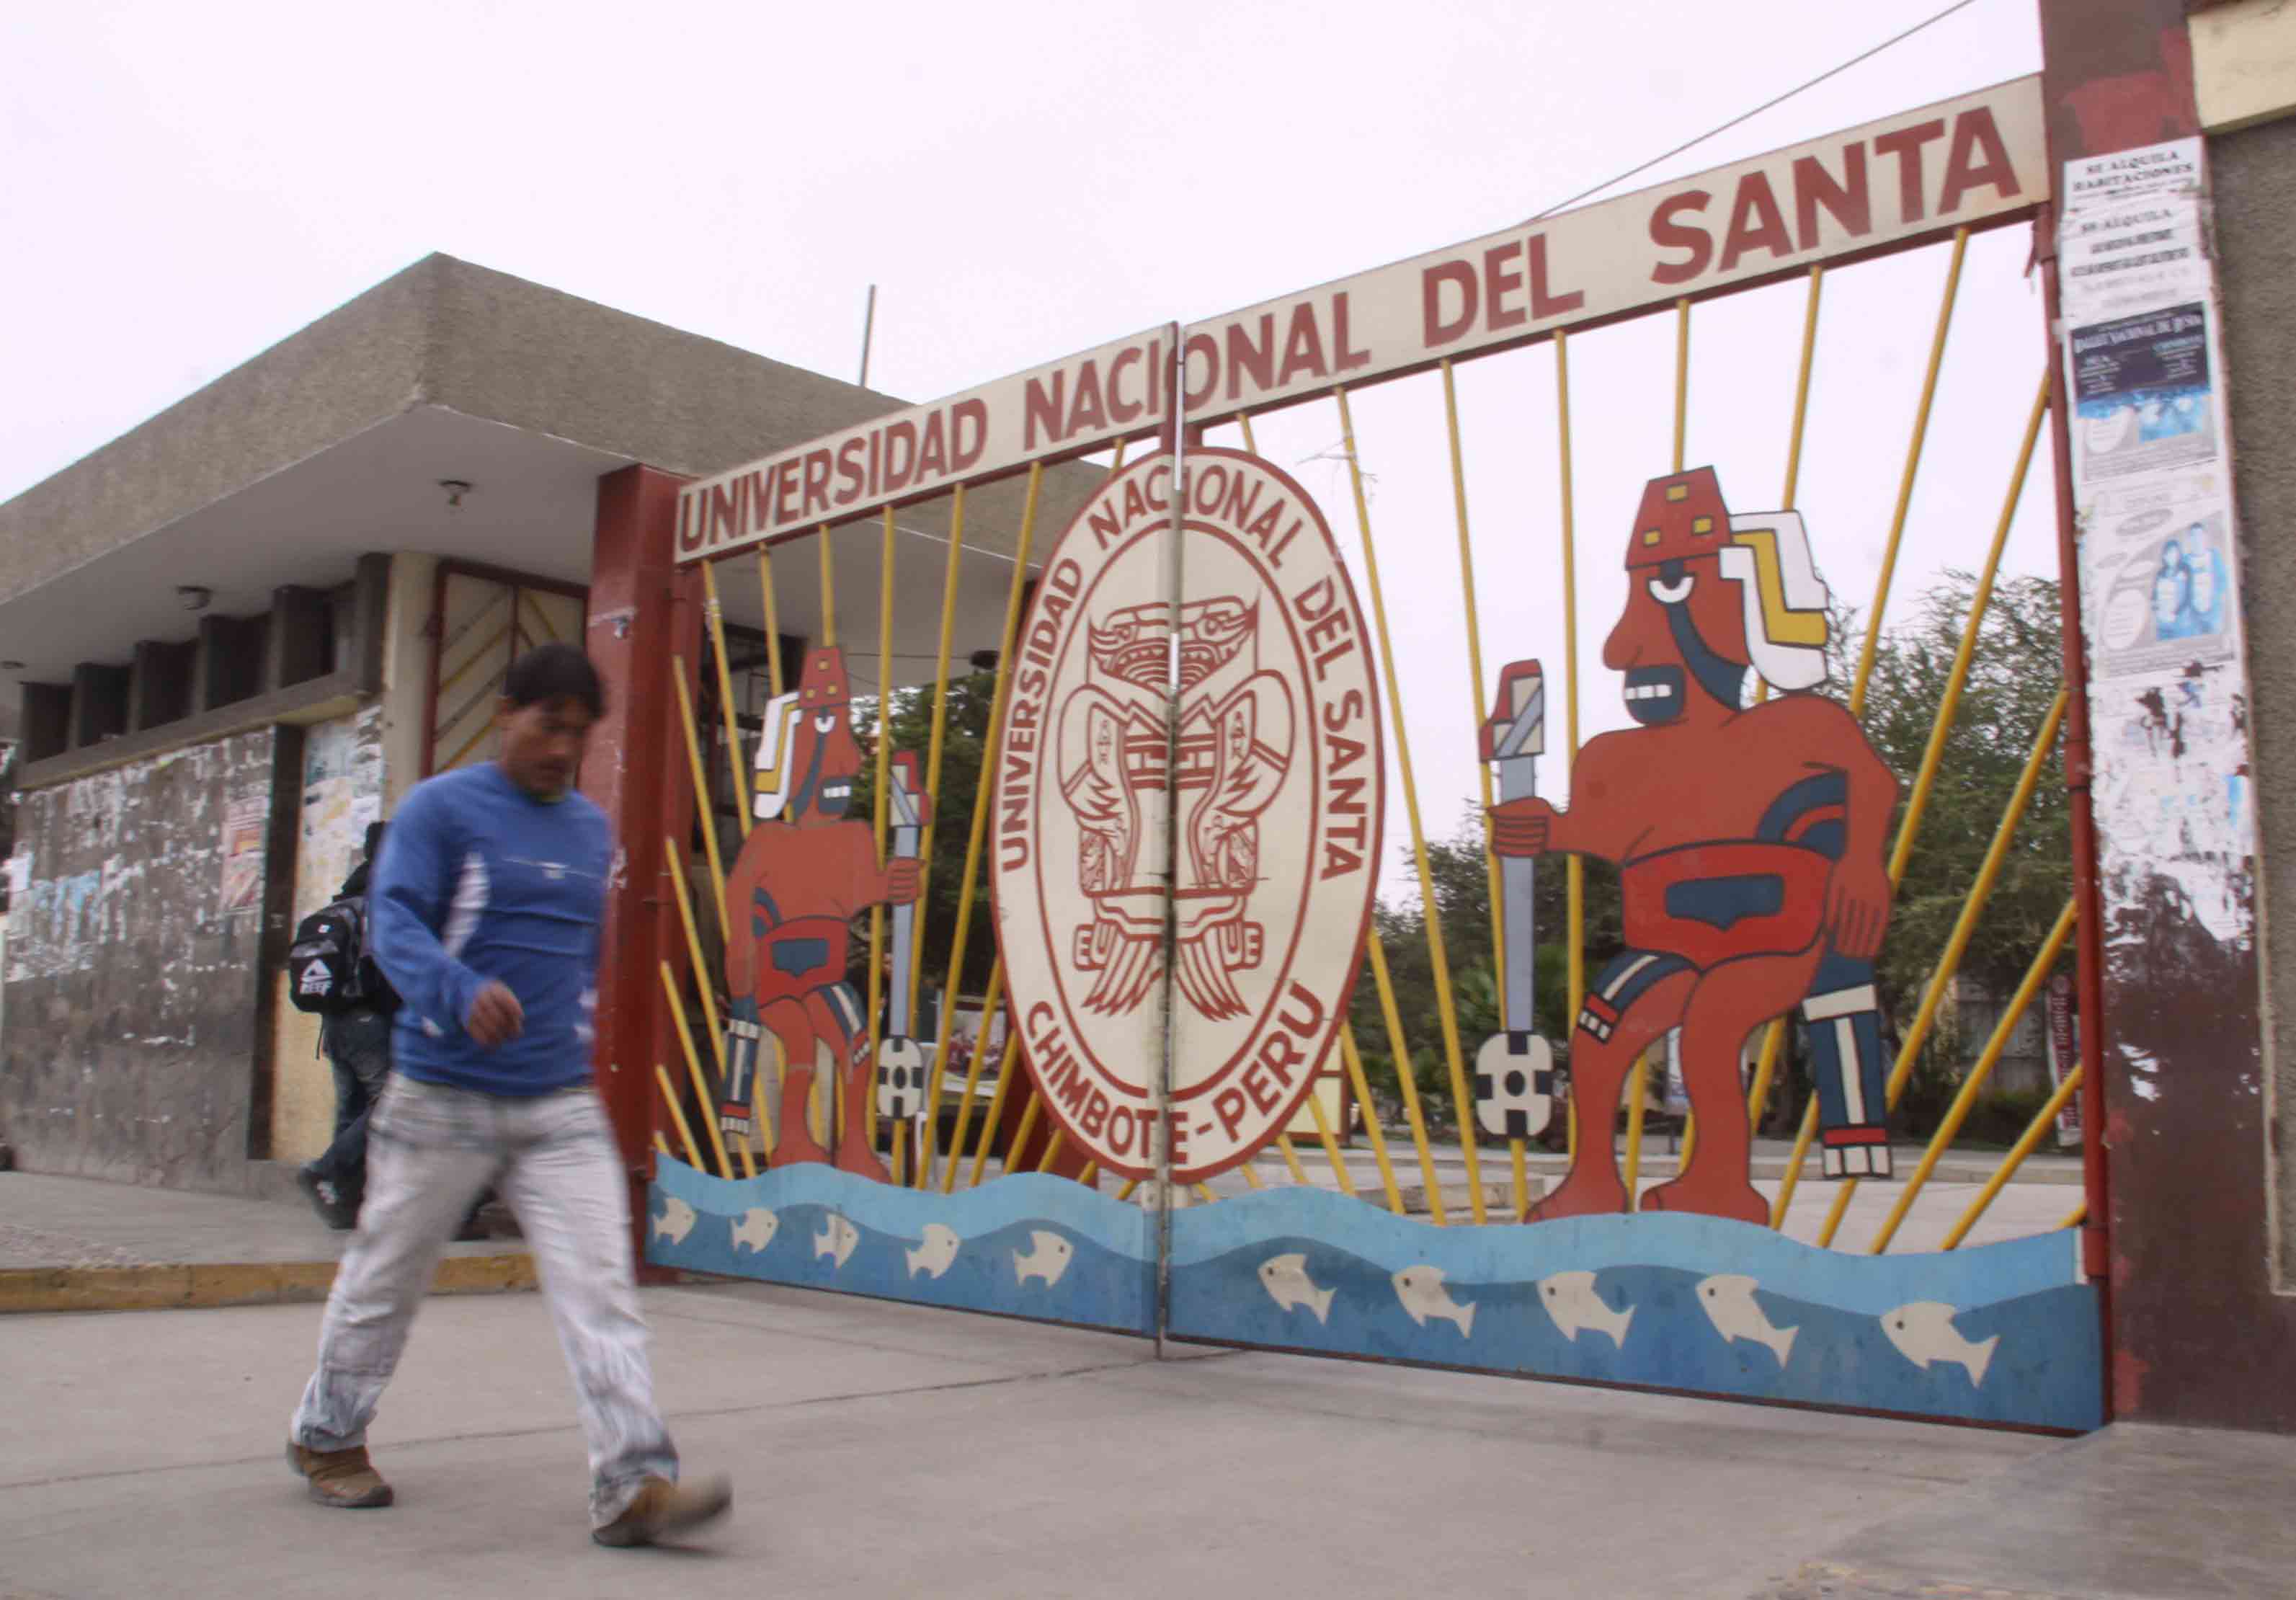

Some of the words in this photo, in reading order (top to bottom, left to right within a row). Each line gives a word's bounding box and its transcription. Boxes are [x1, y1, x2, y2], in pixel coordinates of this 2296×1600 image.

[2111, 151, 2179, 171] ALQUILA
[680, 398, 989, 554] UNIVERSIDAD
[1023, 290, 1372, 452] NACIONAL
[1422, 232, 1585, 349] DEL
[1649, 105, 2022, 285] SANTA
[1087, 464, 1304, 569] NACIONAL
[1295, 574, 1356, 683] DEL
[1002, 557, 1083, 871] UNIVERSIDAD
[1324, 688, 1367, 881] SANTA
